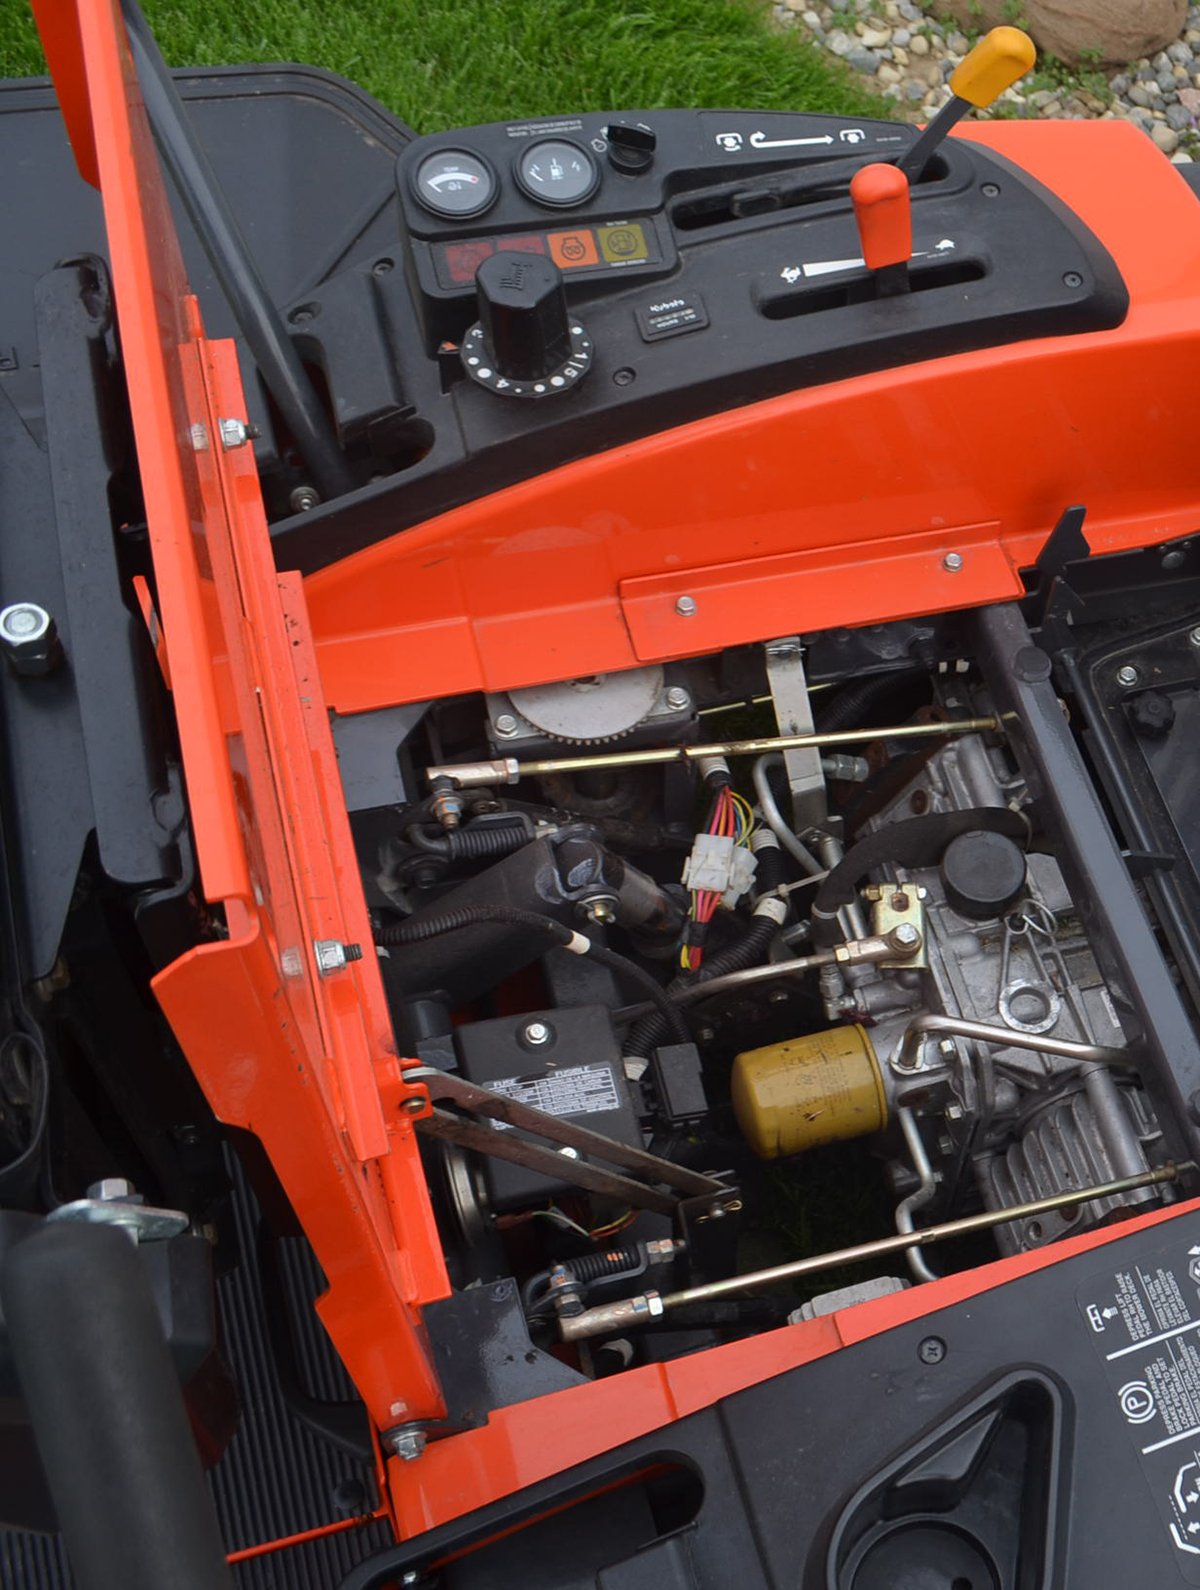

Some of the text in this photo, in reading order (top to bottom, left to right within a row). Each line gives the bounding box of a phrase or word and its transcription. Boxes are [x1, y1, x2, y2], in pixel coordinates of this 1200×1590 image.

[649, 299, 685, 312] Kubota
[495, 378, 510, 389] 4
[1114, 1271, 1146, 1338] PEDAL RH TO RAISE
[1114, 1291, 1139, 1341] DEPRESS LIFT
[1131, 1293, 1147, 1321] MOWER
[1142, 1320, 1153, 1335] THE
[1143, 1365, 1176, 1435] DEPRESS PARKING
[1150, 1362, 1183, 1432] BRAKE PEDAL AND
[1156, 1355, 1190, 1429] LOCK PEDAL TO SET
[1178, 1392, 1197, 1426] PARKING
